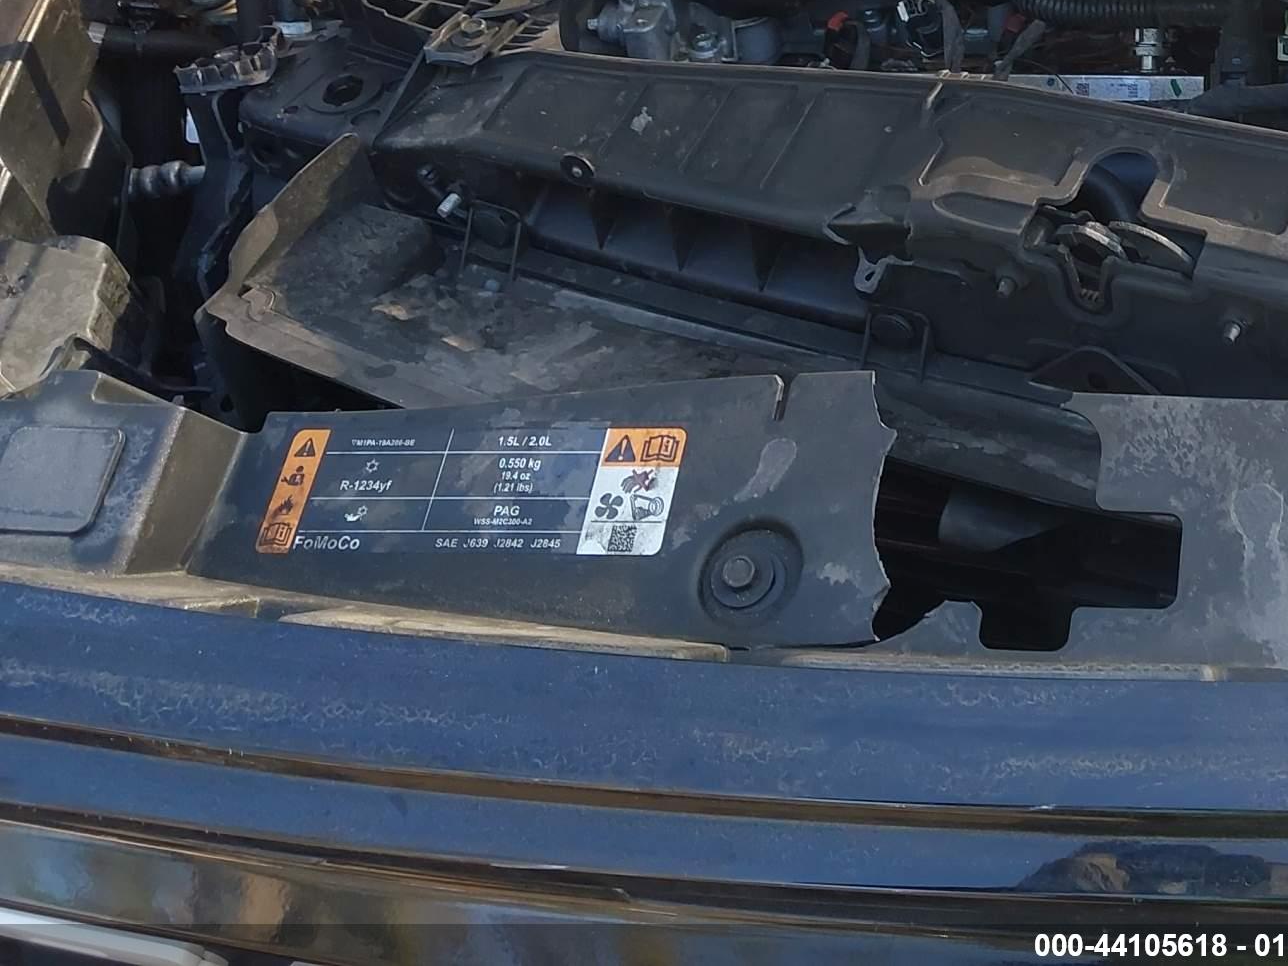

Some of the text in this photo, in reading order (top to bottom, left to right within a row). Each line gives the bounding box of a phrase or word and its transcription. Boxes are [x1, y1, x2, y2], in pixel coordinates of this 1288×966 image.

[498, 436, 552, 447] 1.5L / 2.0L
[499, 458, 541, 471] 0.550 kg
[501, 471, 518, 480] 19.4
[340, 480, 392, 493] R-1234yf
[493, 482, 533, 494] (1.21 lbs)
[493, 505, 520, 516] PAG
[293, 535, 360, 550] FoMoCo
[435, 538, 561, 548] SAE J639 J2842 J2845
